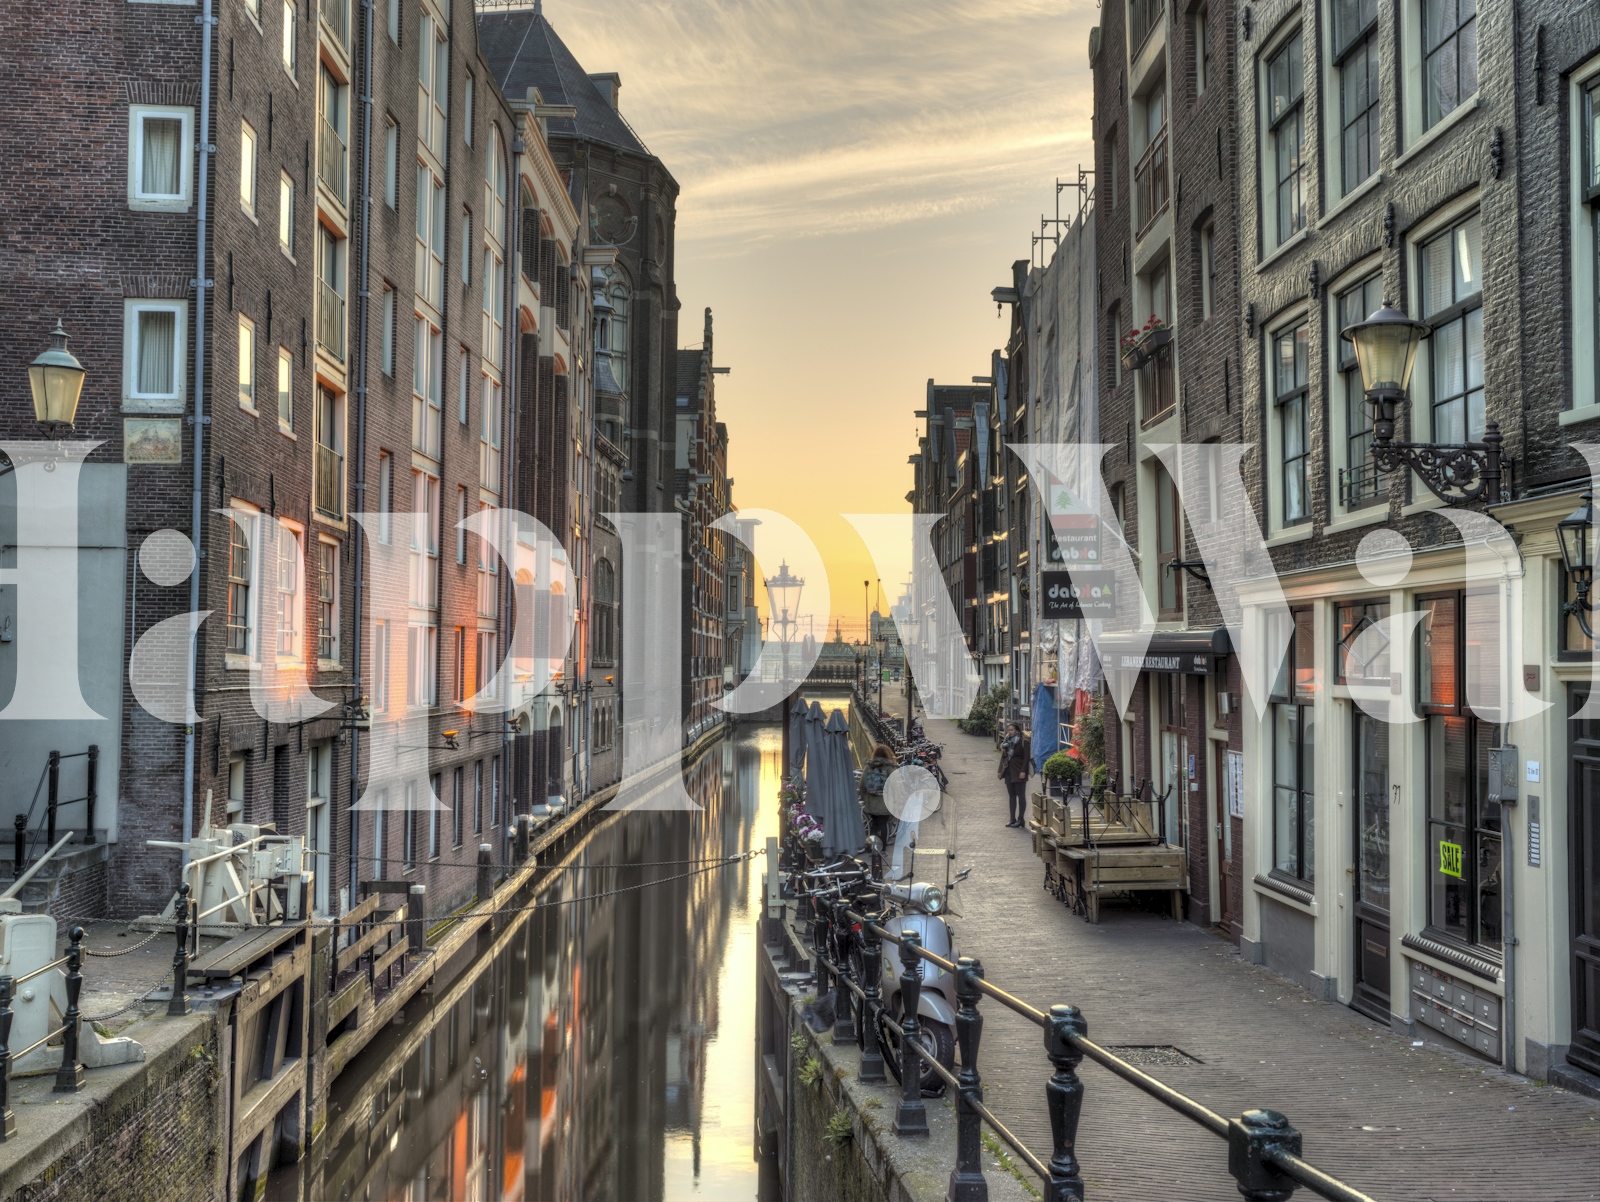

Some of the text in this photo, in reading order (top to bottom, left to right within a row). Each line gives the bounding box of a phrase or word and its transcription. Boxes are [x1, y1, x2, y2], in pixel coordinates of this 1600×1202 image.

[1051, 534, 1097, 542] Restaurant
[1121, 655, 1144, 668] LEBANESE
[1144, 656, 1180, 669] RESTAURANT
[1442, 844, 1460, 873] SALE
